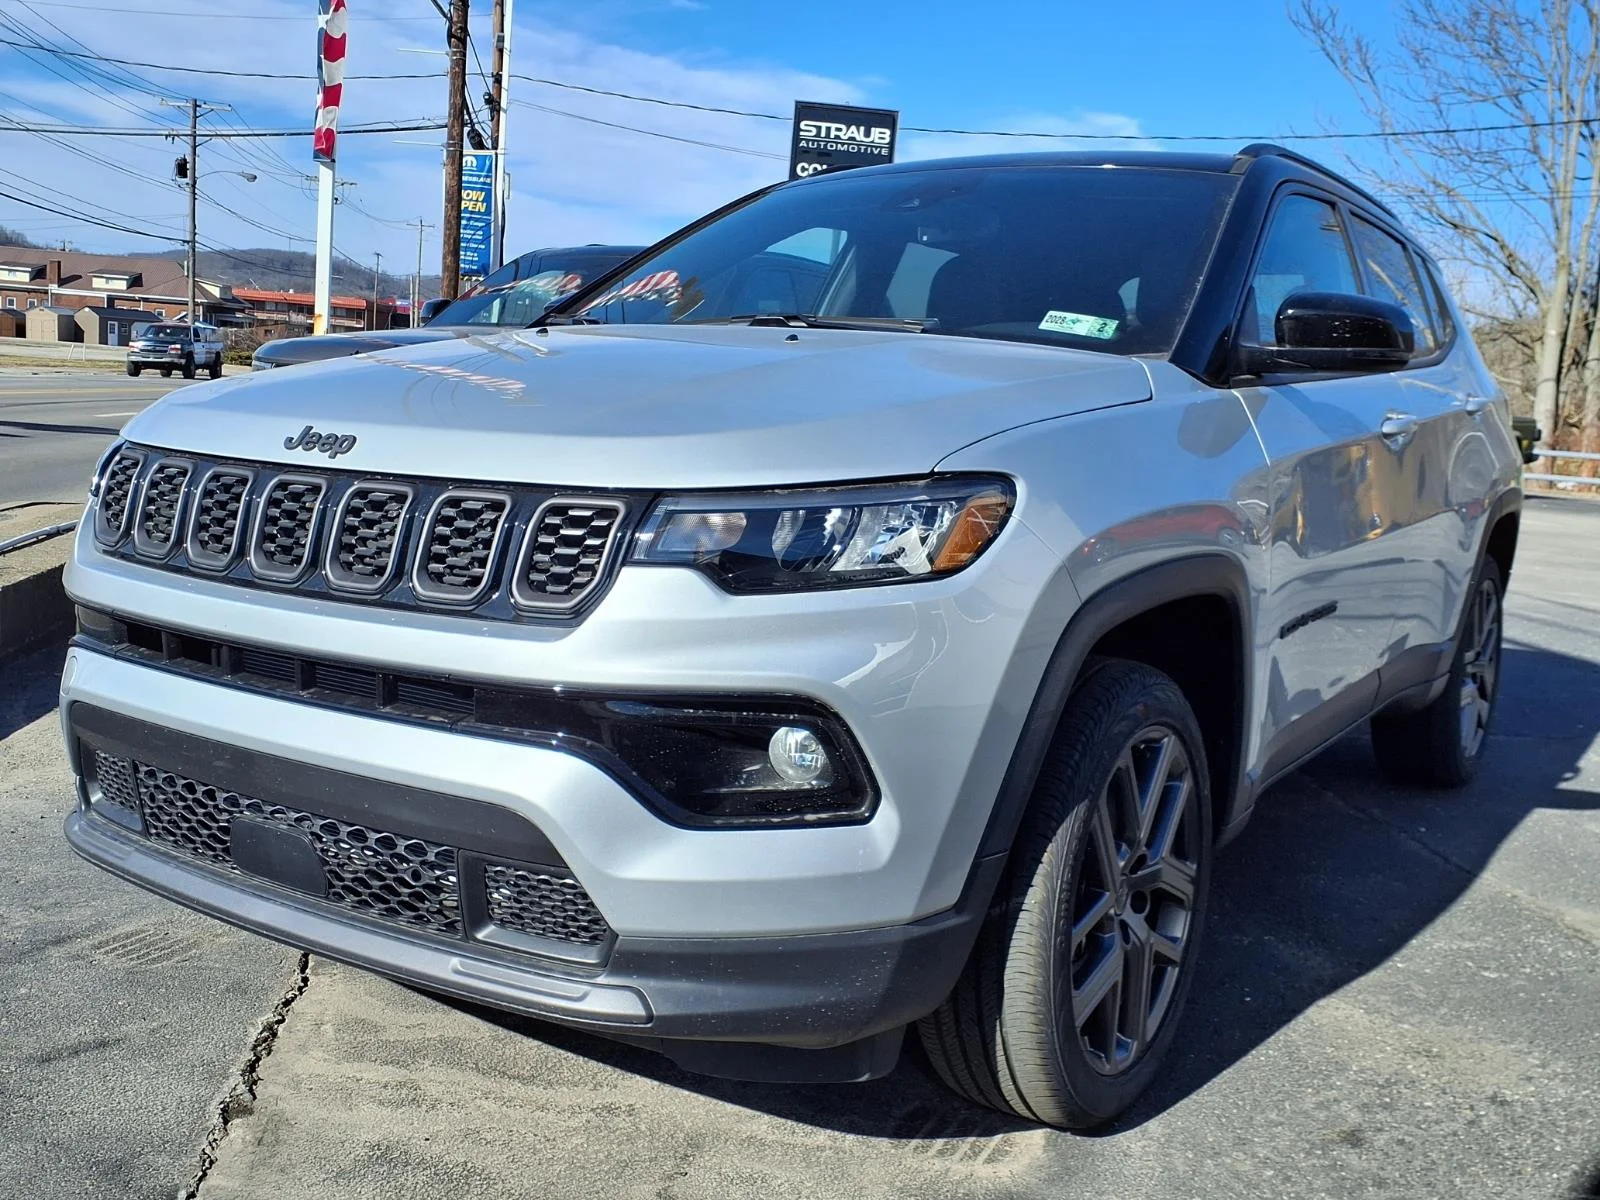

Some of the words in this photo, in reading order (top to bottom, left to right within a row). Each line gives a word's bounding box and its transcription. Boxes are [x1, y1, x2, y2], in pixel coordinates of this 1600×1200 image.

[799, 120, 891, 144] STRAUB
[798, 140, 889, 156] AUTOMOTIVE
[796, 162, 828, 177] CO
[461, 189, 486, 202] OW
[460, 200, 487, 213] PEN
[1096, 322, 1108, 333] 2
[283, 425, 358, 459] Jeep
